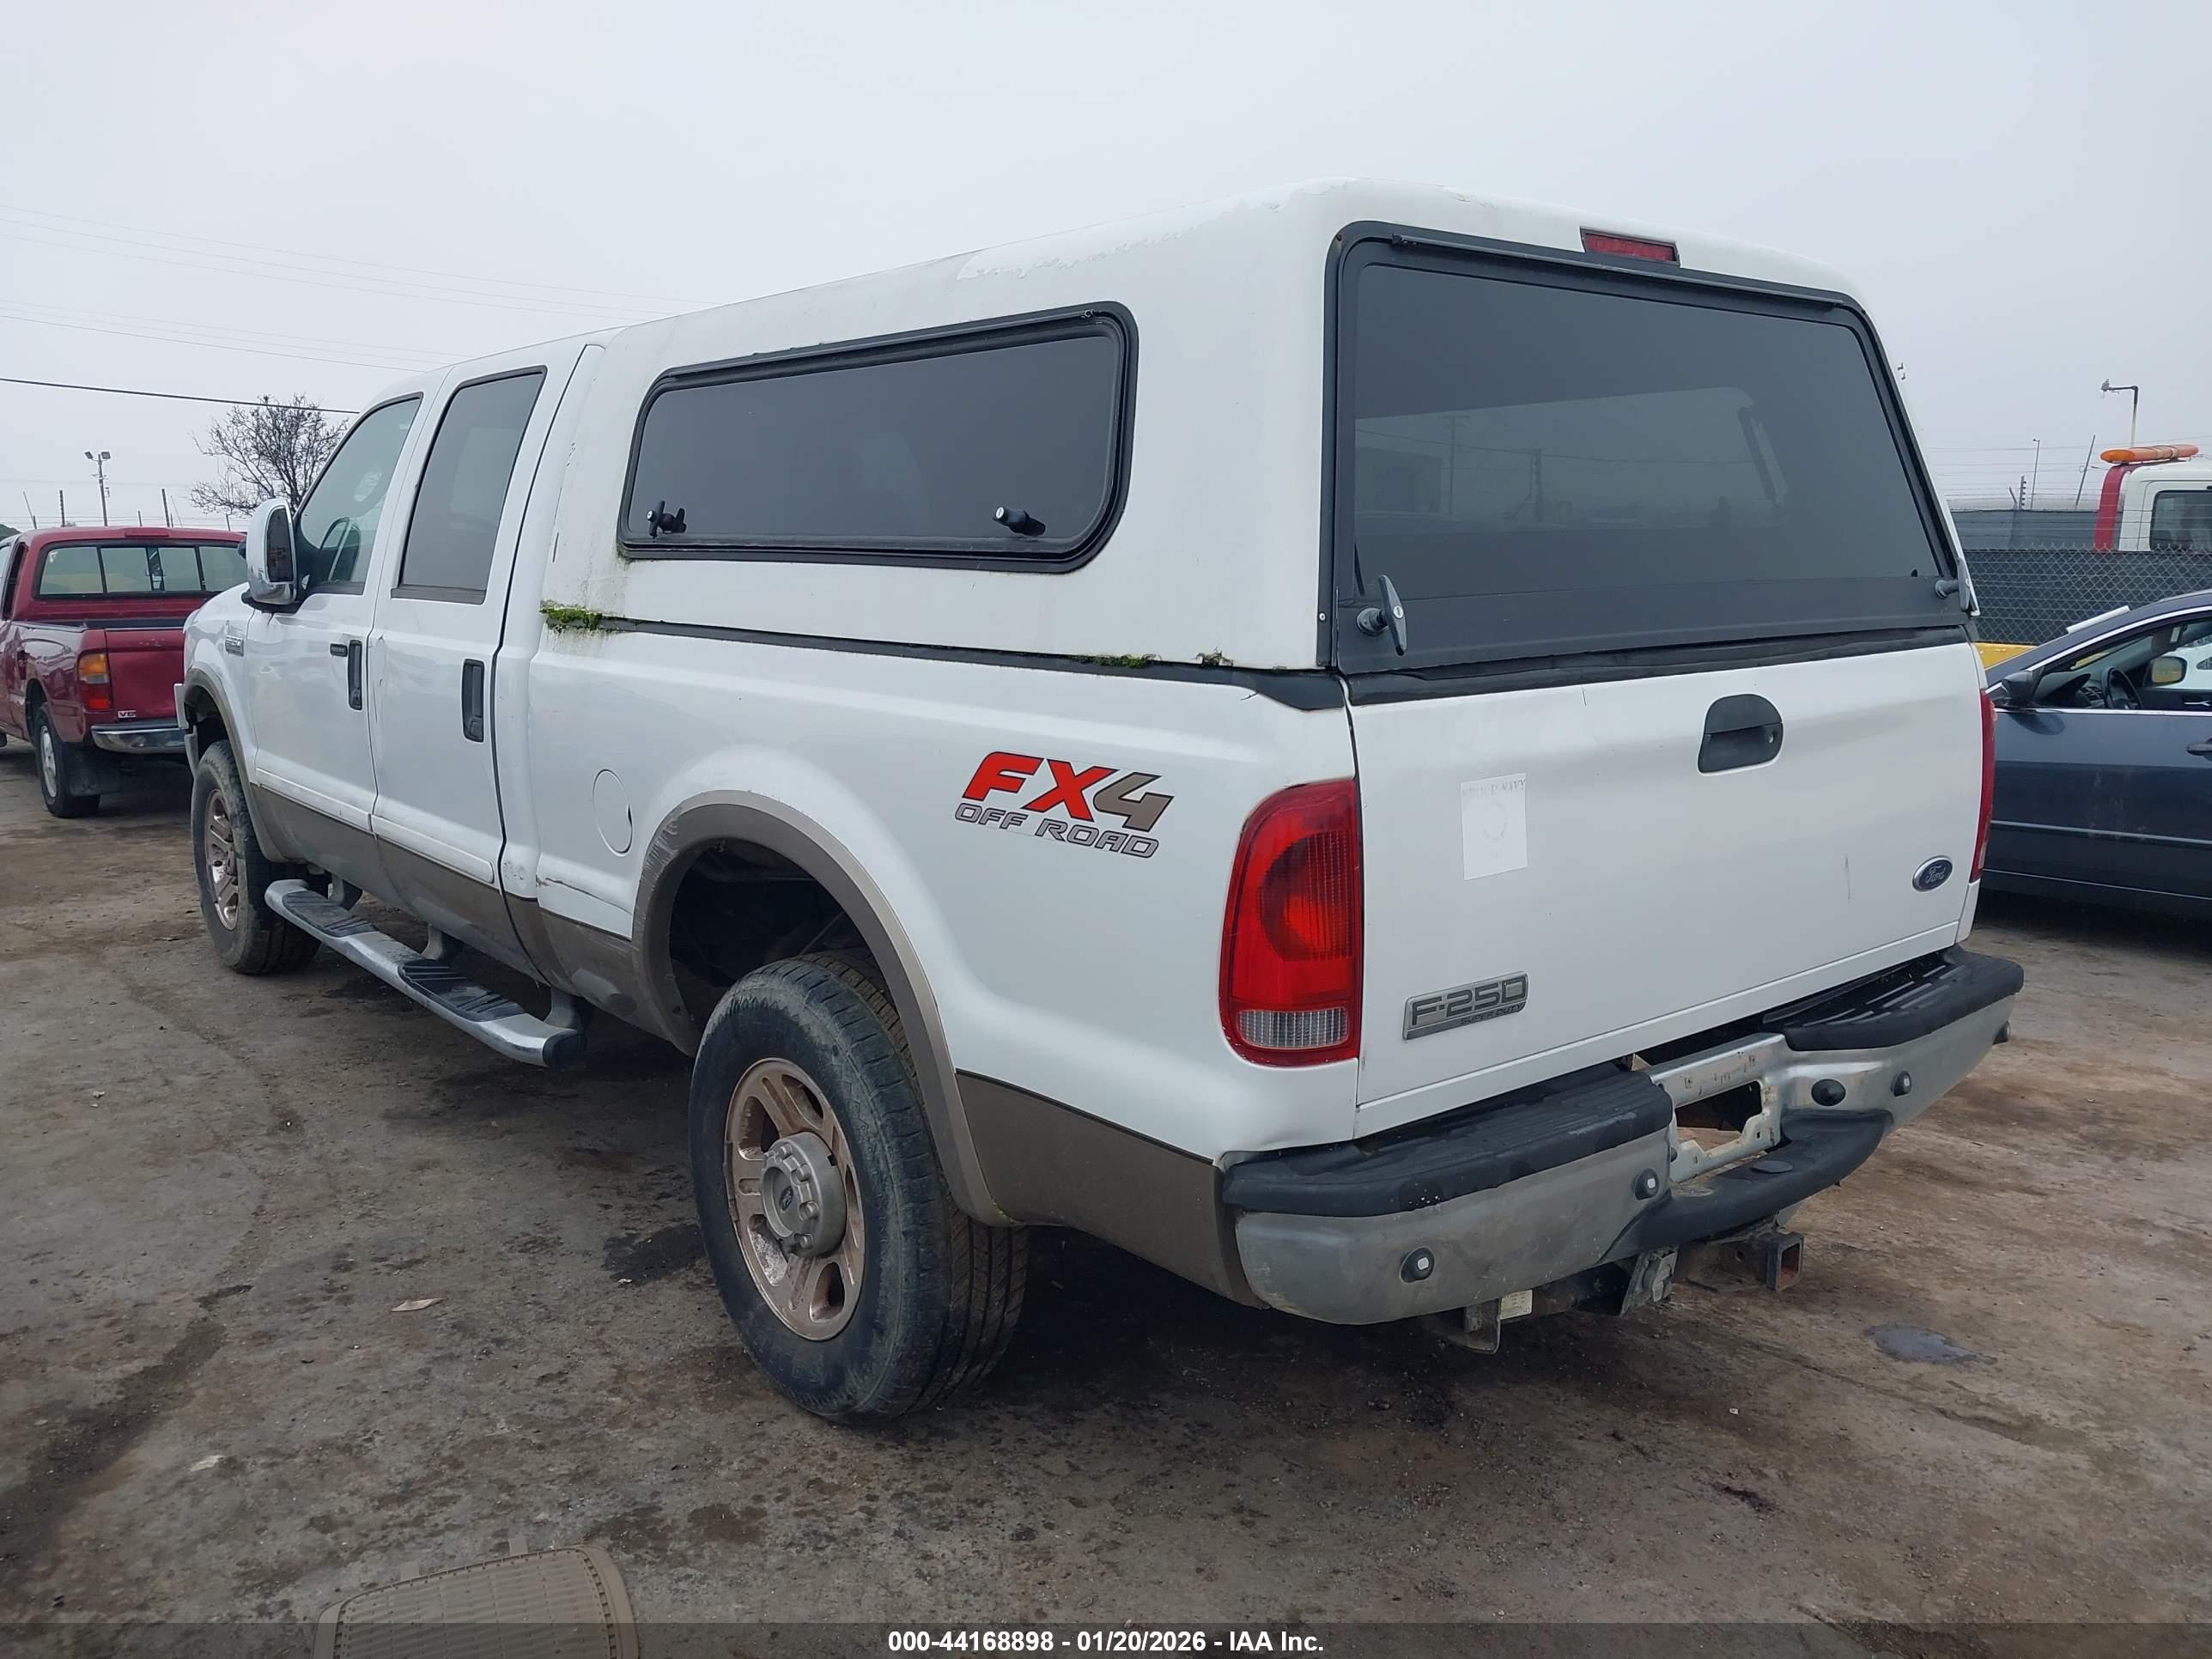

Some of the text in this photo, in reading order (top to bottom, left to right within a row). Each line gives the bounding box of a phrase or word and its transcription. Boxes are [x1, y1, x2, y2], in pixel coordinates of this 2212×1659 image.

[961, 750, 1176, 833] FX4
[954, 802, 1159, 859] OFF ROAD
[1411, 975, 1527, 1026] F-250
[1461, 1001, 1525, 1024] SUPER DUTY
